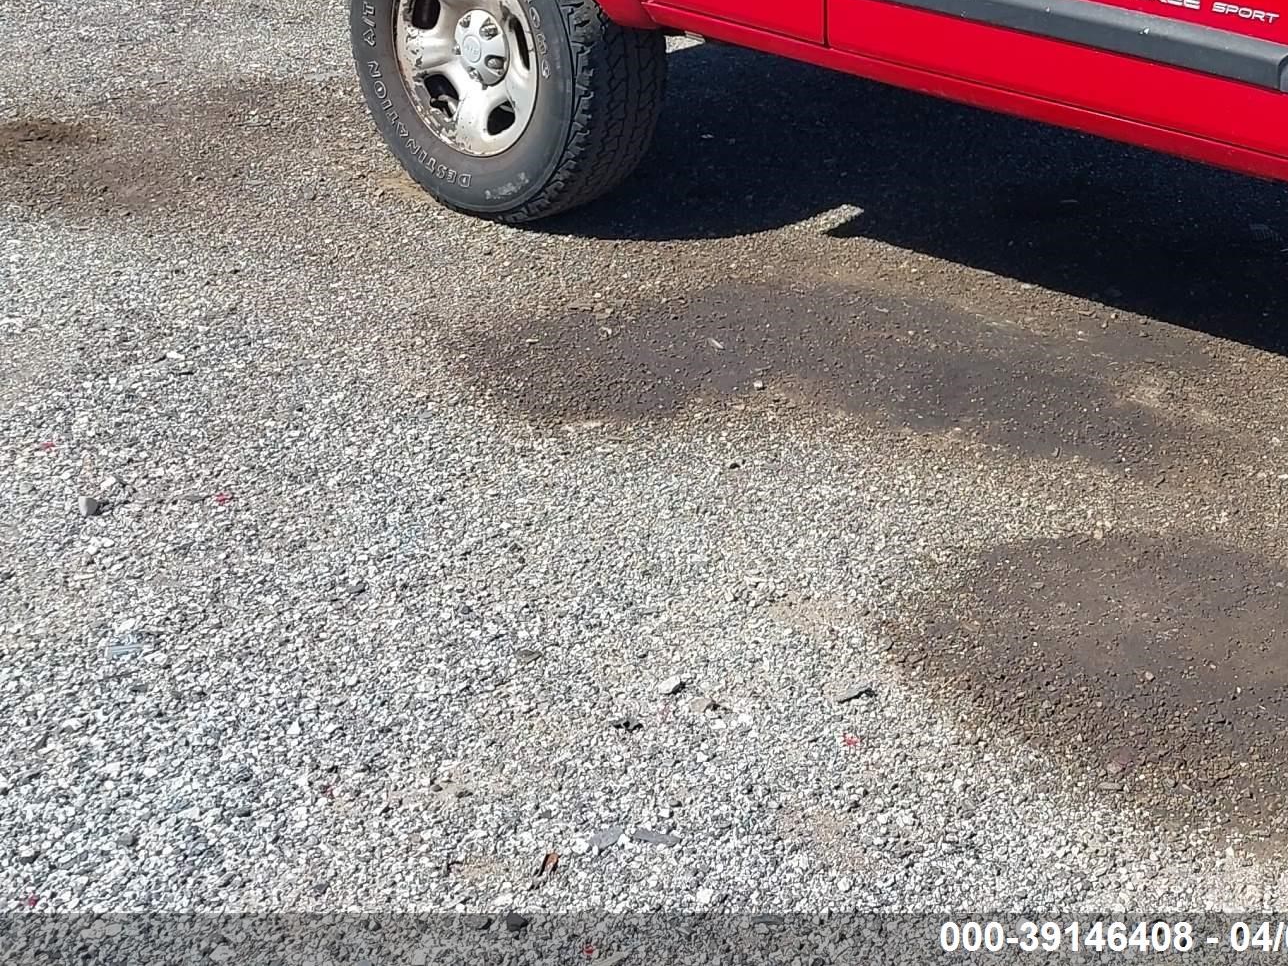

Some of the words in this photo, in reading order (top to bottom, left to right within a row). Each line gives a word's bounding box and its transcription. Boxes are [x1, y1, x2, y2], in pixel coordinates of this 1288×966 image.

[362, 0, 377, 47] A/T
[1211, 1, 1280, 24] SPORT
[367, 60, 472, 188] DESTINATION
